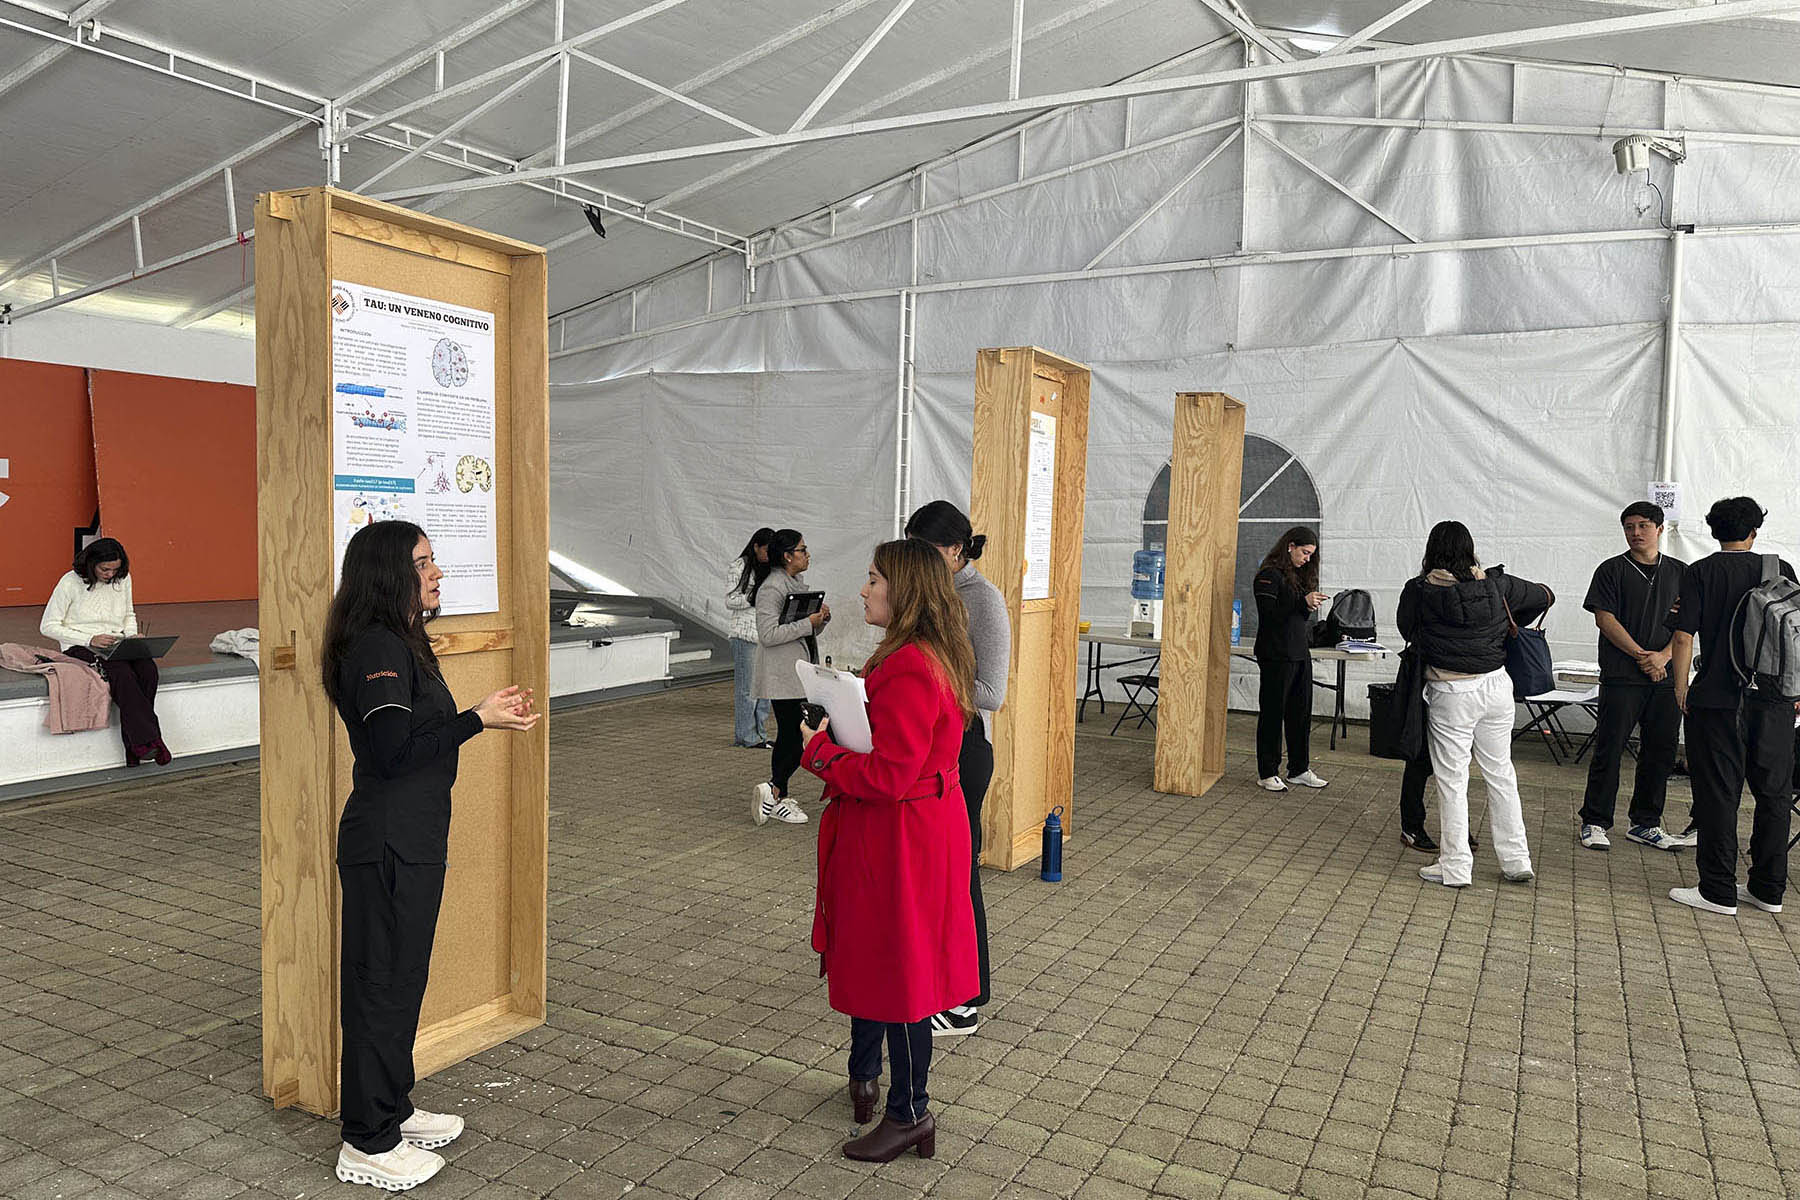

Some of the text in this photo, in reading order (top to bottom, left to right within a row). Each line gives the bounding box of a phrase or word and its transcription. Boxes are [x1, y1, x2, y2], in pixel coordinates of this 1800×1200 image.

[363, 298, 387, 311] TAU:
[388, 303, 402, 313] UN
[403, 306, 442, 321] VENENO
[443, 314, 489, 331] COGNITIVO
[366, 670, 398, 681] Nutrición
